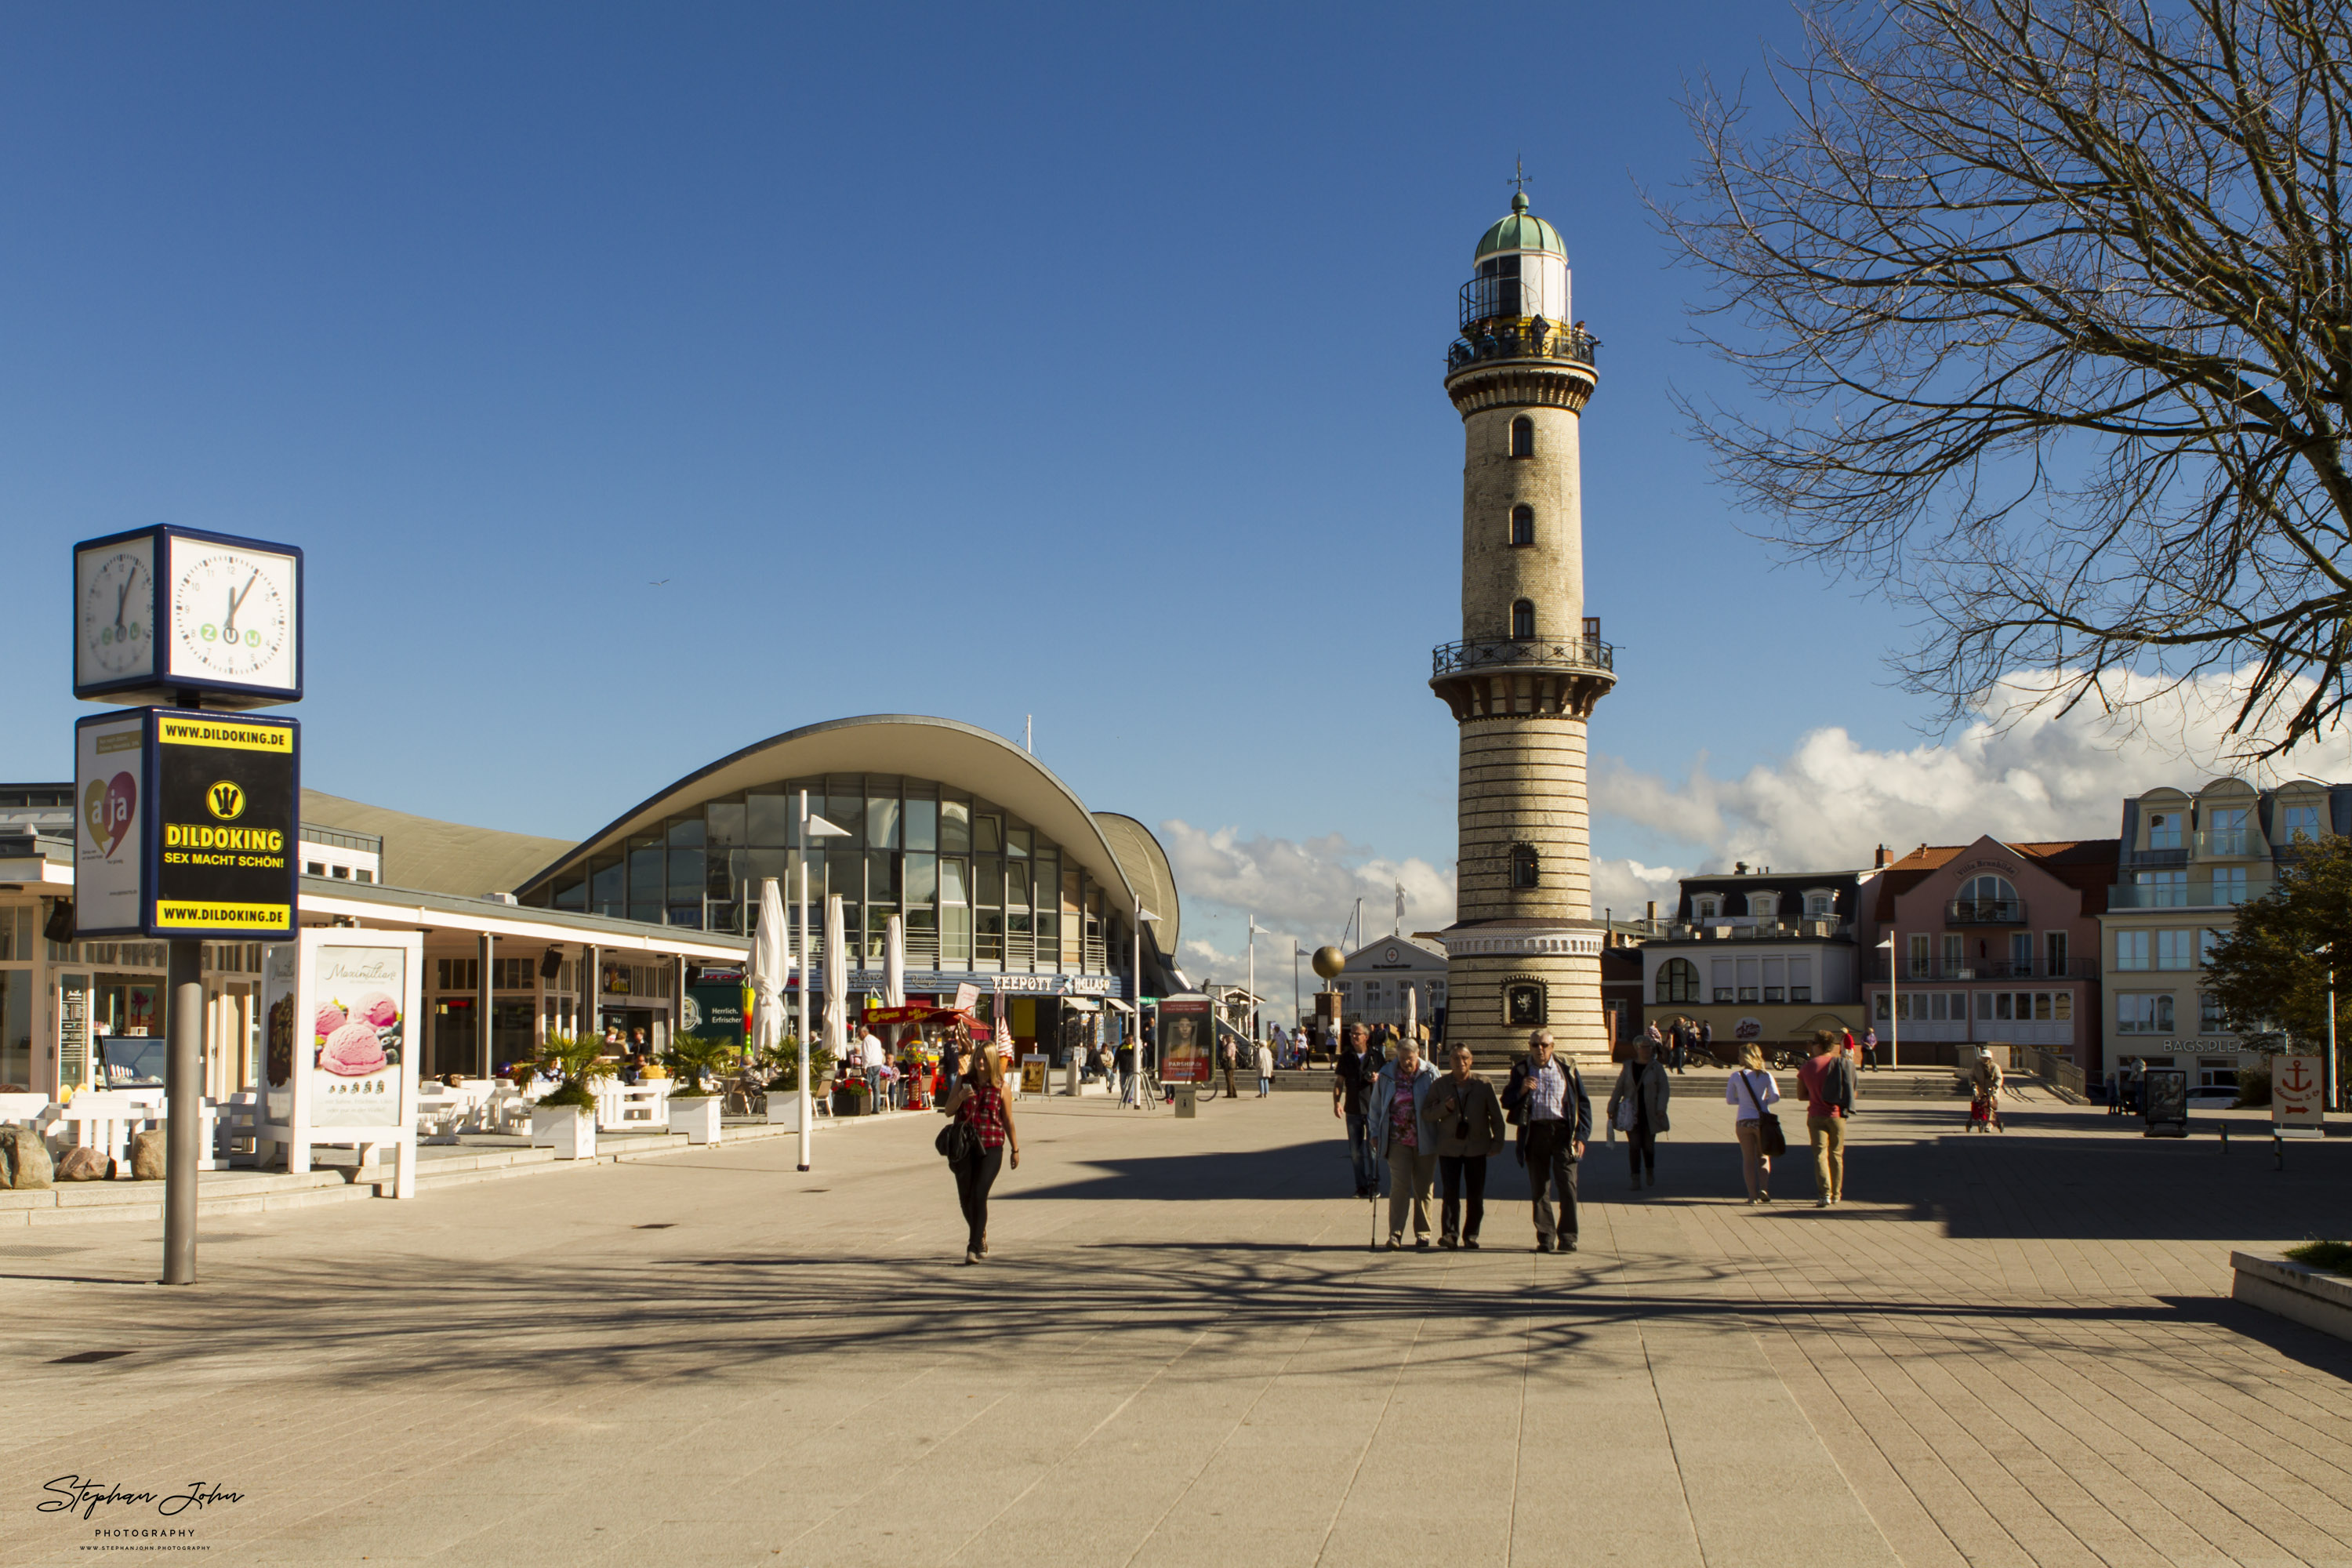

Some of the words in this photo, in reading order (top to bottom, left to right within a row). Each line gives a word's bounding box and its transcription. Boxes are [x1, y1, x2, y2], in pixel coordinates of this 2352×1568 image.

[165, 724, 285, 746] WWW.DILDOKING.DE
[165, 824, 285, 853] DILDOKING
[164, 852, 190, 863] SEX
[192, 854, 236, 866] MACHT
[238, 855, 285, 868] SCHÖN!
[163, 907, 283, 923] WWW.DILDOKING.DE
[991, 976, 1052, 991] TEEPOTT
